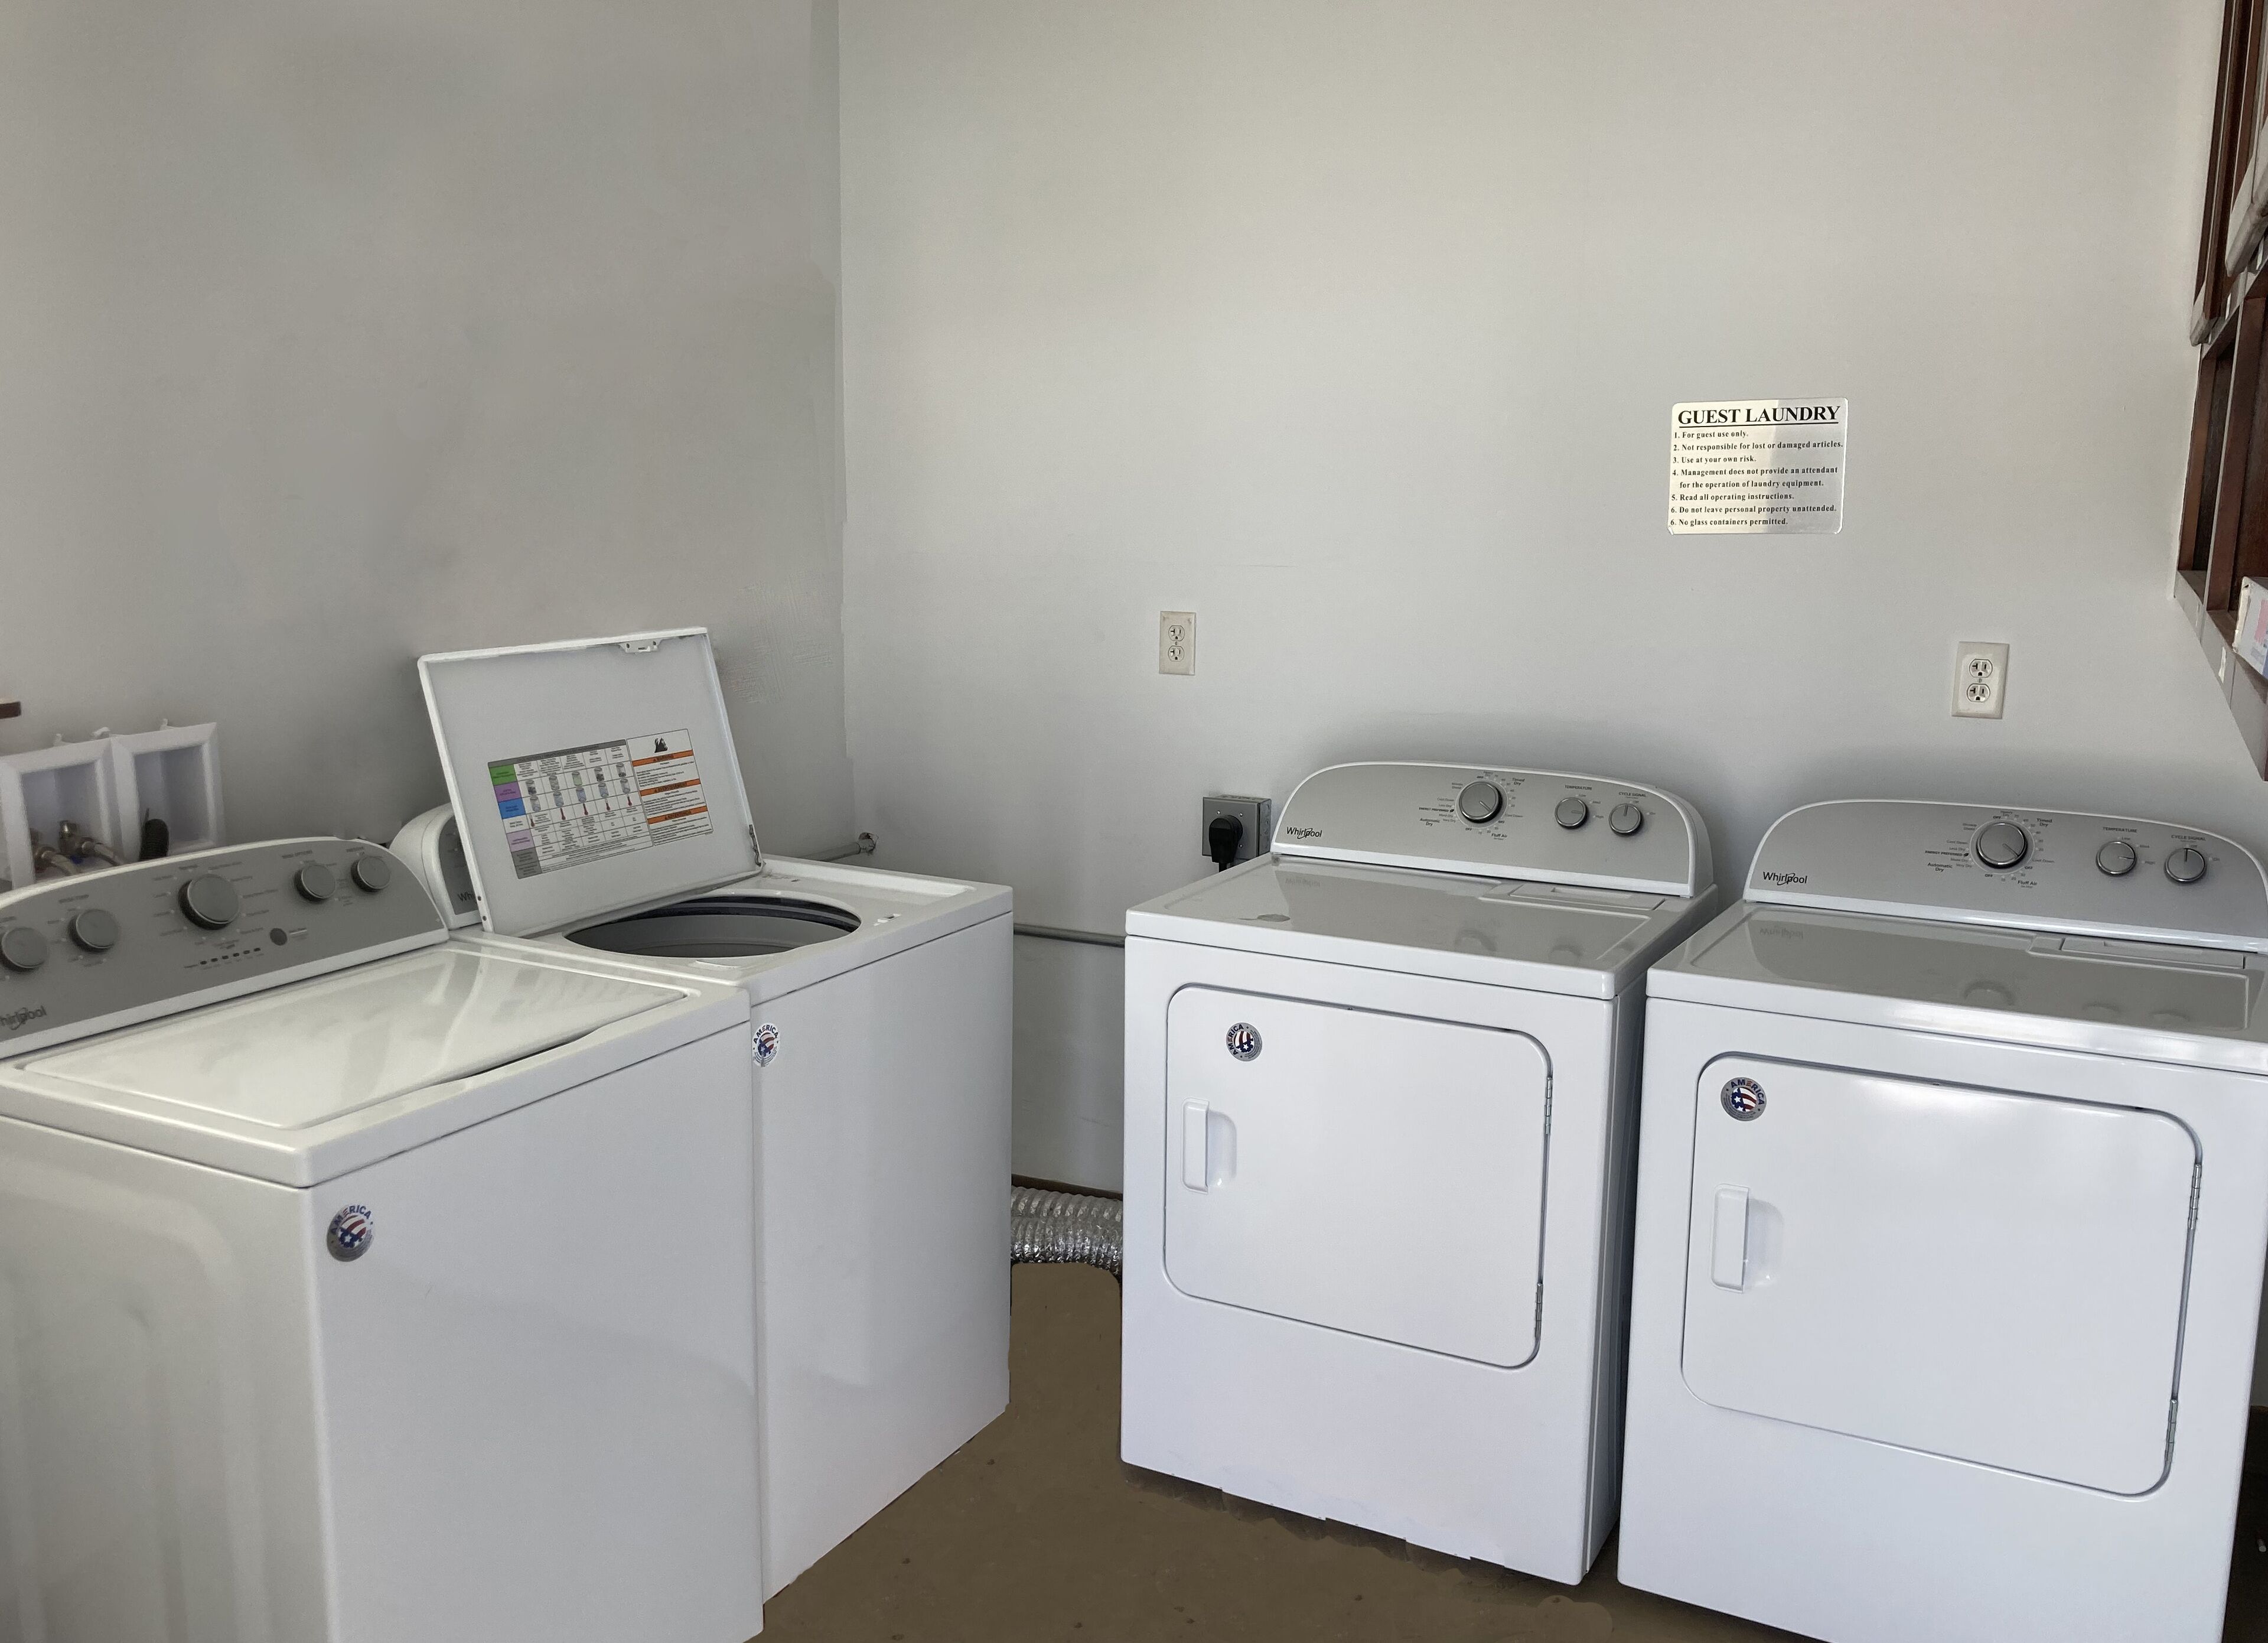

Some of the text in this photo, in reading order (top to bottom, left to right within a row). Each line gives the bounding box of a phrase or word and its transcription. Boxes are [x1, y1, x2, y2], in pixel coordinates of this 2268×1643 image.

[1678, 405, 1841, 424] GUEST LAUNDRY
[1696, 431, 1715, 440] guest
[1696, 443, 1738, 452] responsible
[1777, 441, 1810, 450] damaged
[1681, 469, 1726, 477] Management
[1761, 467, 1789, 476] provide
[1705, 481, 1740, 489] operation
[1782, 480, 1824, 488] equipment.
[1710, 493, 1746, 502] operating
[1725, 506, 1756, 514] personal
[1286, 827, 1322, 839] Whirlpool
[1762, 871, 1808, 886] Whirlpool
[0, 1005, 47, 1030] hirlpool
[753, 1024, 779, 1045] AMERICA
[1227, 1024, 1244, 1055] AMERICA
[1731, 1079, 1765, 1105] AMERICA
[330, 1204, 372, 1235] AMERICA
